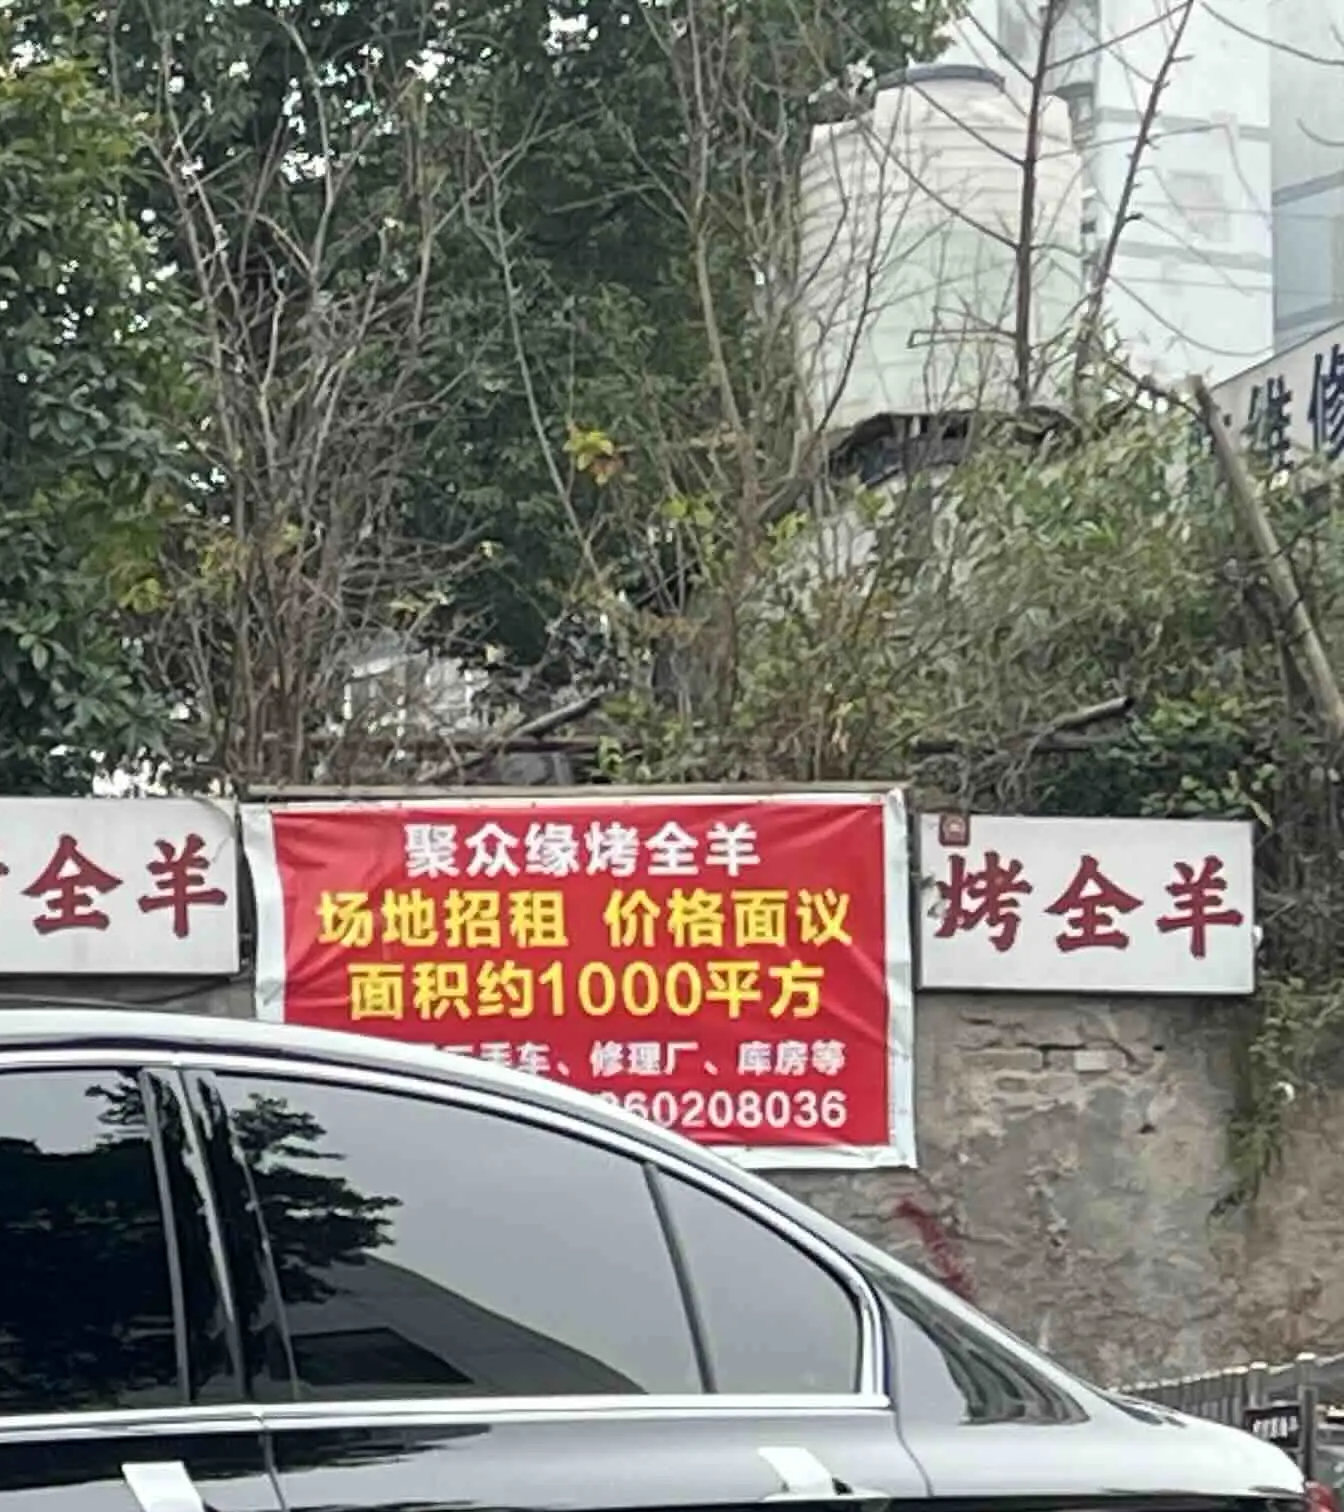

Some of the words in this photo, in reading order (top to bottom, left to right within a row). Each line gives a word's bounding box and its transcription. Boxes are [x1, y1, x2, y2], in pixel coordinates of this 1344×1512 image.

[404, 823, 761, 877] 聚众缘烤全羊
[317, 890, 568, 948] 场地招租
[603, 889, 853, 947] 价格面议
[935, 852, 1244, 959] 烤全羊
[349, 961, 825, 1021] 面积约1000平方
